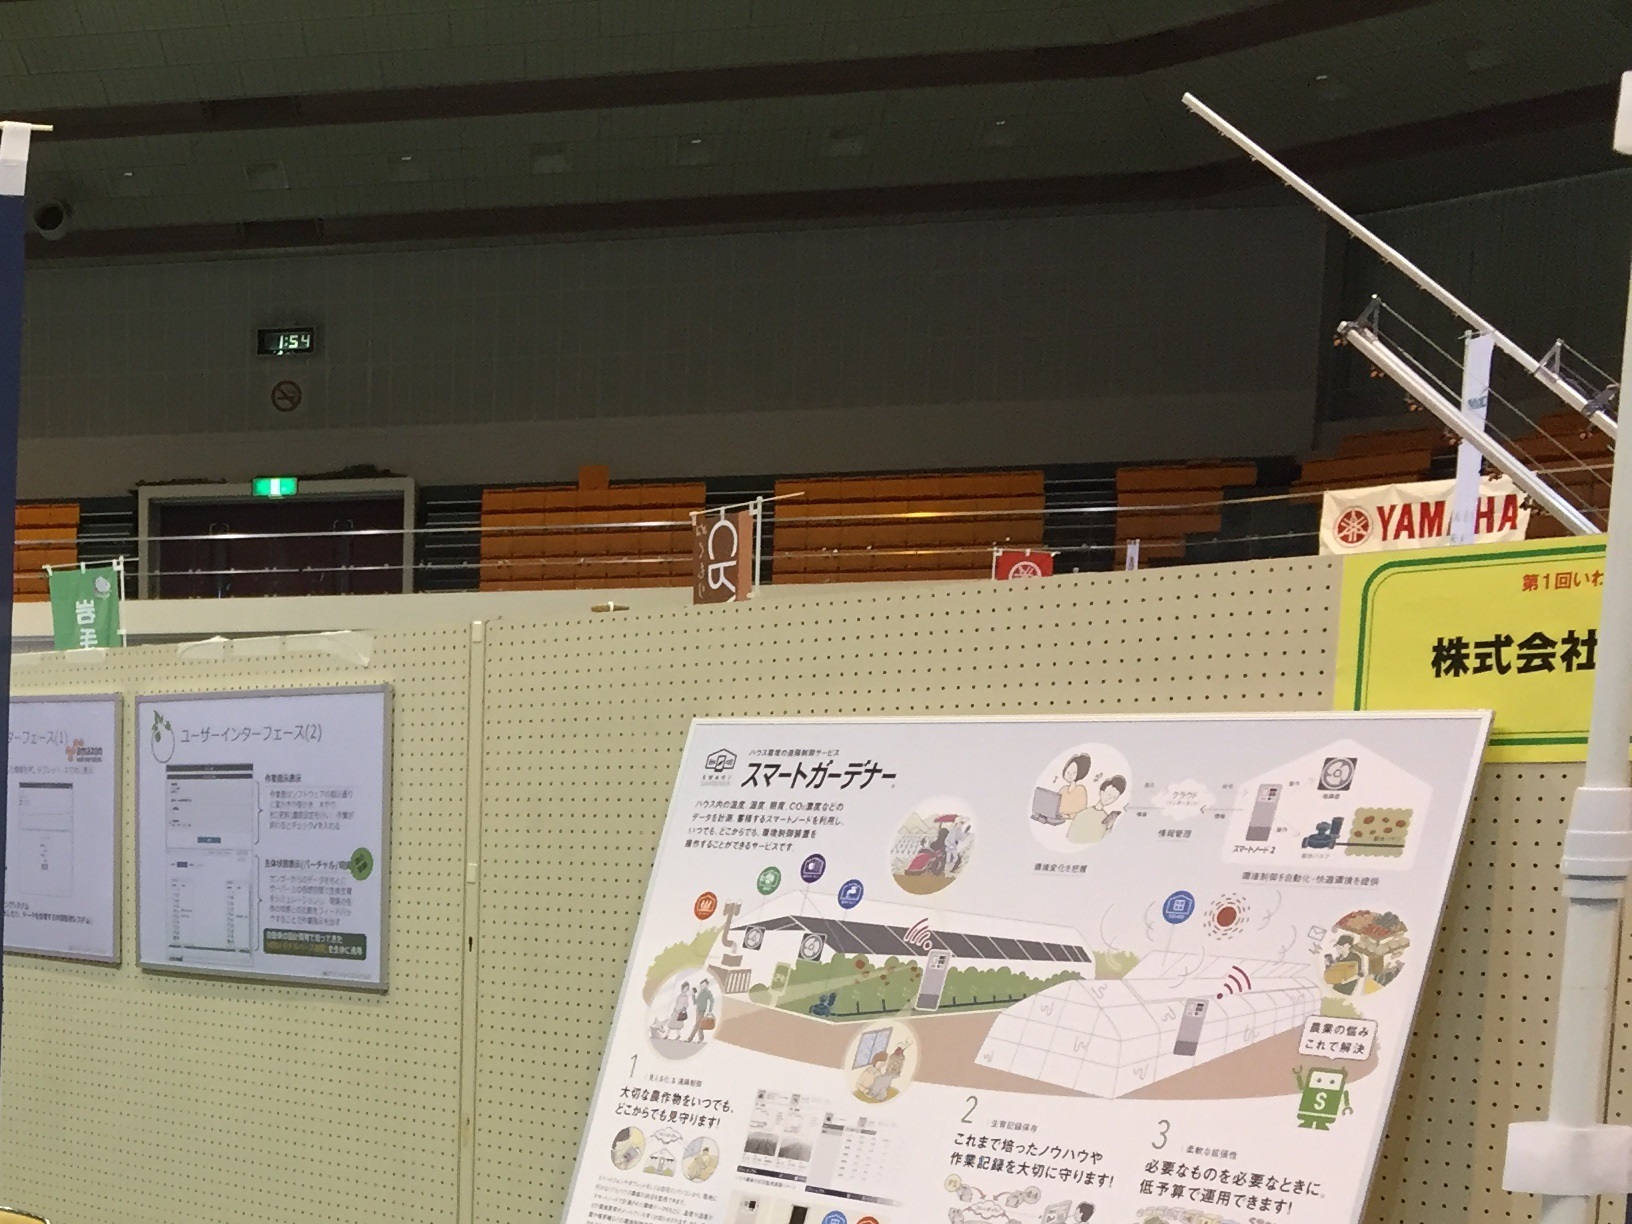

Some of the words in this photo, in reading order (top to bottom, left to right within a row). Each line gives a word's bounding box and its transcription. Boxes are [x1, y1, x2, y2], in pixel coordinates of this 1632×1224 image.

[278, 334, 311, 349] 1:54
[1376, 493, 1519, 541] YAMHA
[1431, 628, 1599, 679] 株式会社
[180, 723, 323, 743] ユーザーインターフェース(2)
[741, 759, 898, 790] スマートガーデナー
[1309, 1022, 1369, 1037] 農業の悩み
[1305, 1039, 1365, 1055] これで解決
[953, 1133, 1104, 1165] これまで培ったノウハウや
[950, 1152, 1115, 1189] 作業記録を大切に守ります!
[1144, 1159, 1326, 1199] 必要なものを必要なときに。
[1139, 1179, 1293, 1215] 低予算で運用できます!
